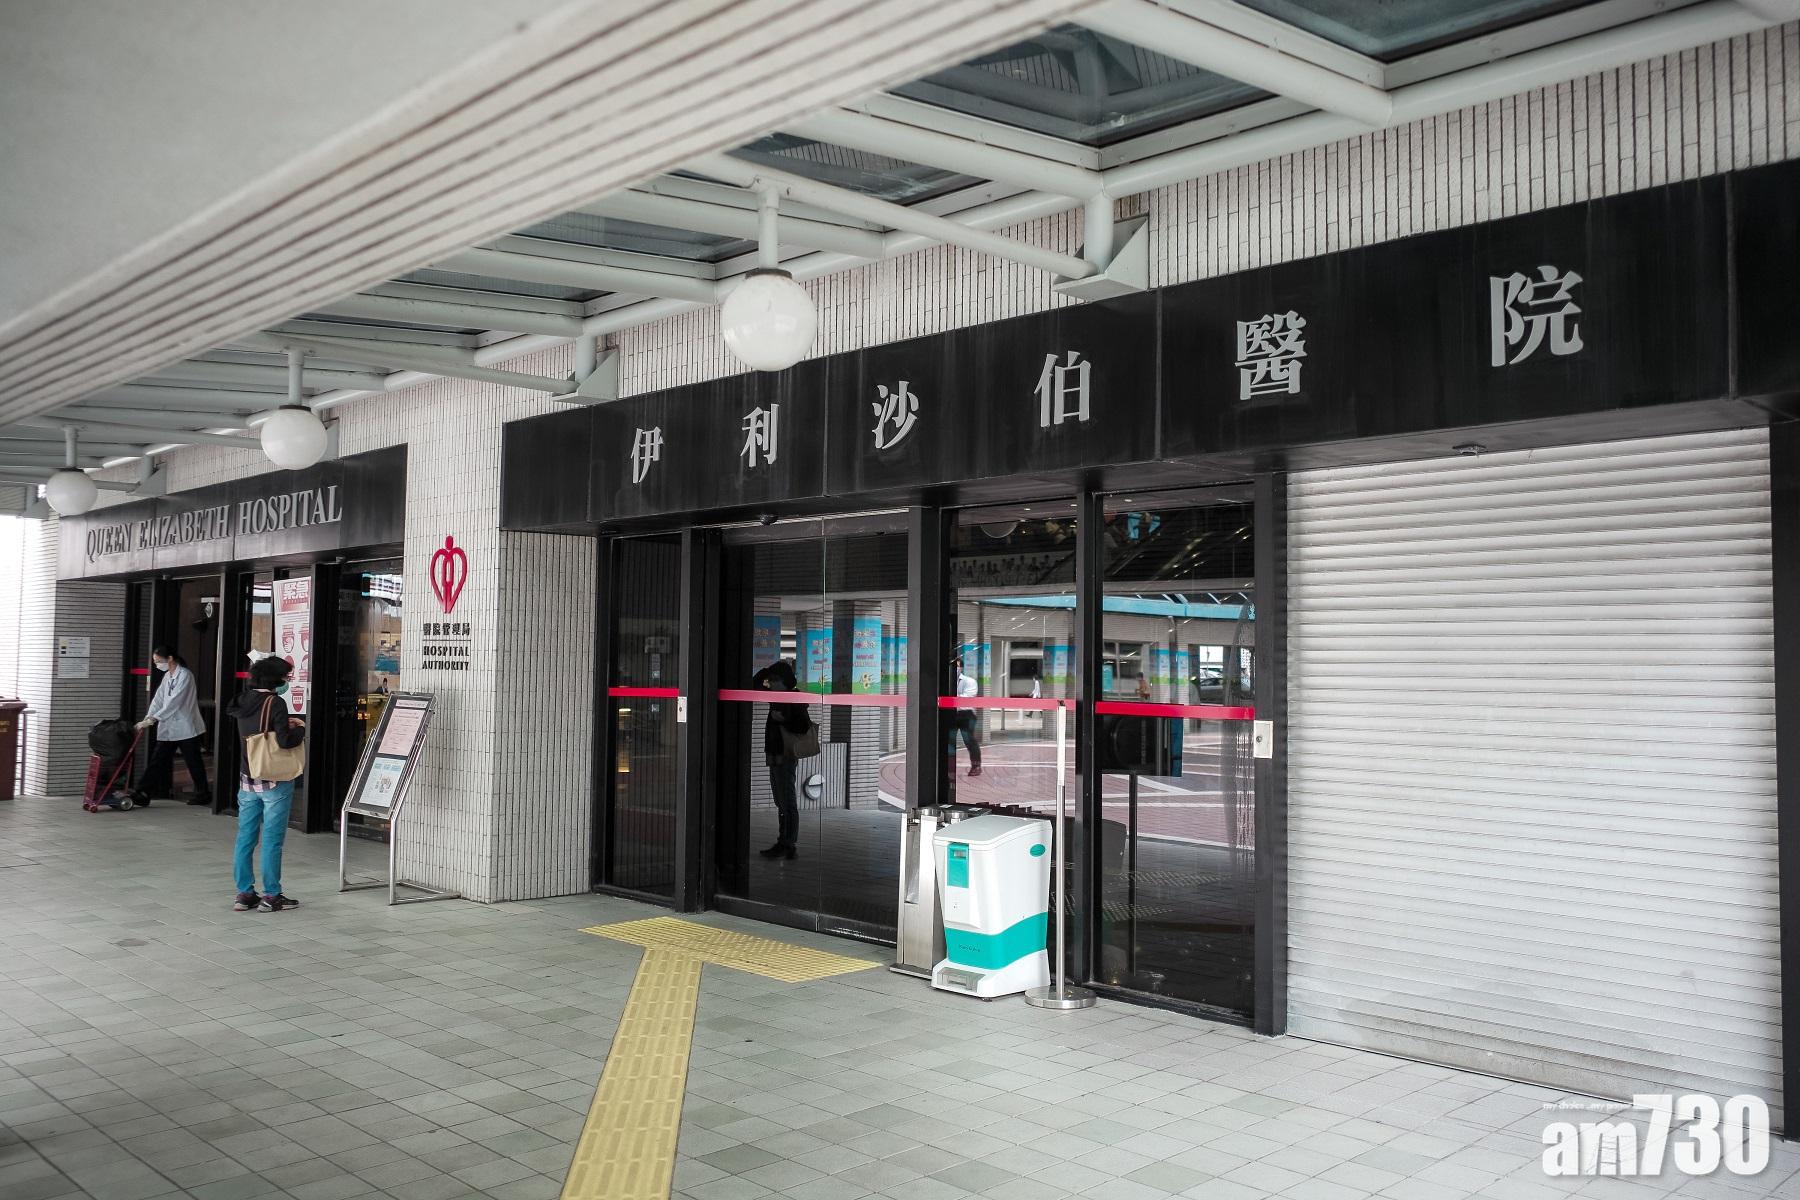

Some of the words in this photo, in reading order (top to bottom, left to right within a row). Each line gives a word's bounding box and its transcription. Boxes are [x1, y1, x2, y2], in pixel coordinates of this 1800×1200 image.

[630, 264, 1584, 485] 伊利沙伯醫院
[86, 522, 133, 563] QUEEN
[137, 504, 231, 549] ELIZABETH
[237, 485, 343, 536] HOSPITAL
[422, 622, 471, 636] 醫院管理局
[423, 645, 470, 657] HOSPITAL
[421, 660, 470, 671] AUTHORITY
